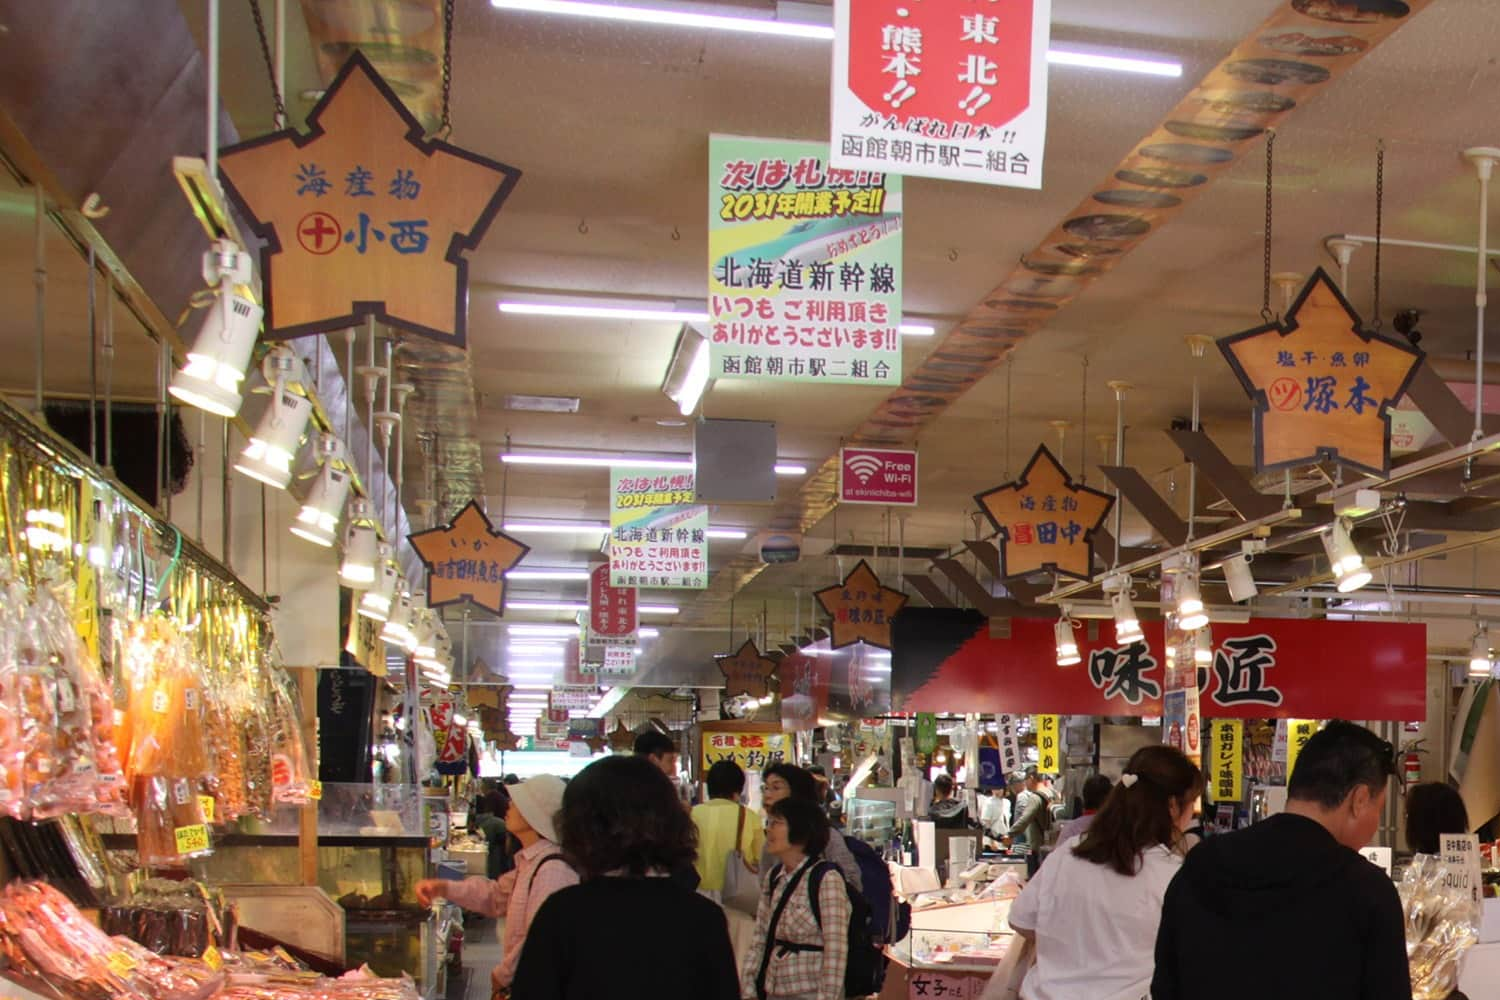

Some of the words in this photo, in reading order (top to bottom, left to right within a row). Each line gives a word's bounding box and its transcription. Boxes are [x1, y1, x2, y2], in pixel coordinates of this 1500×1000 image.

[840, 133, 1030, 175] 函館朝市駅二組合
[294, 163, 422, 201] 海産物
[720, 189, 888, 222] 2031年開業予定!!
[713, 256, 896, 295] 北海道新幹線
[712, 295, 776, 320] いつも
[784, 300, 888, 325] ご利用頂き
[712, 323, 897, 351] ありがとうございます!!
[722, 354, 891, 380] 函館朝市駅二組合
[884, 460, 911, 472] Free
[884, 473, 912, 484] Wi-Fi
[614, 527, 705, 544] 北海道新幹線
[1087, 634, 1283, 706] 味匠
